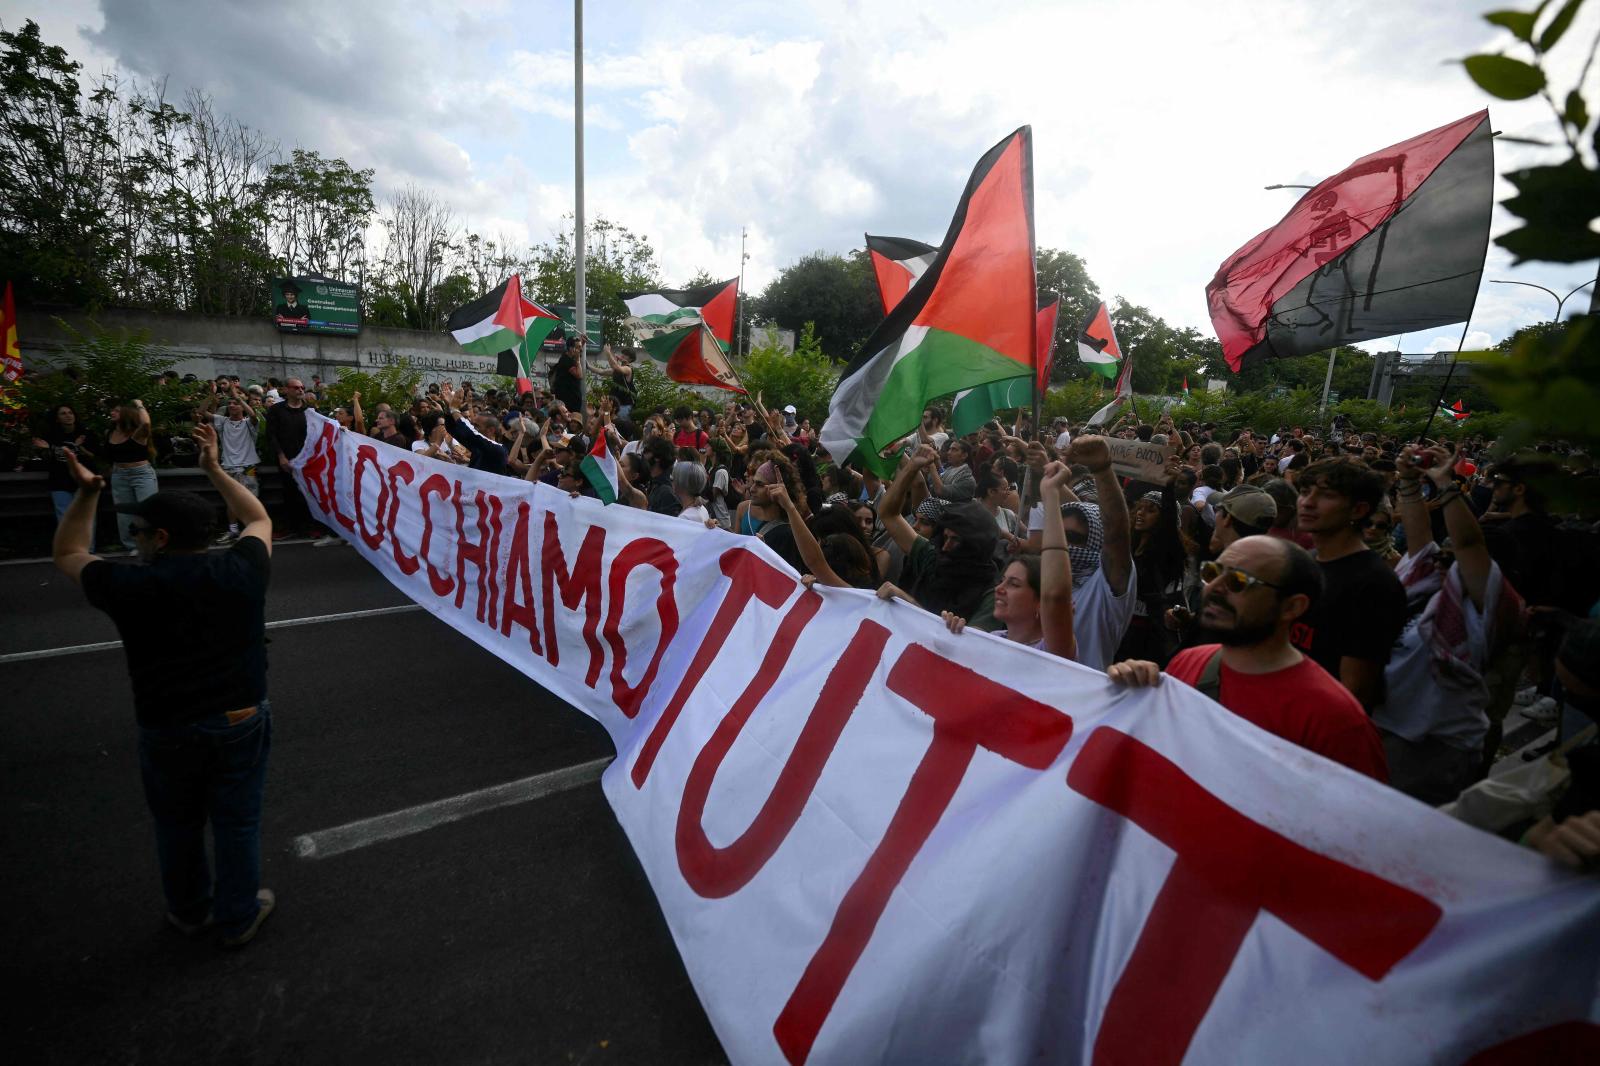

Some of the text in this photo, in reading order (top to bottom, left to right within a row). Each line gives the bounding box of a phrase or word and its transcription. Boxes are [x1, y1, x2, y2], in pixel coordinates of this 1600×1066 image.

[1135, 447, 1164, 465] BLOOD
[302, 421, 1600, 1066] BLOCCHIAMO TUTT
